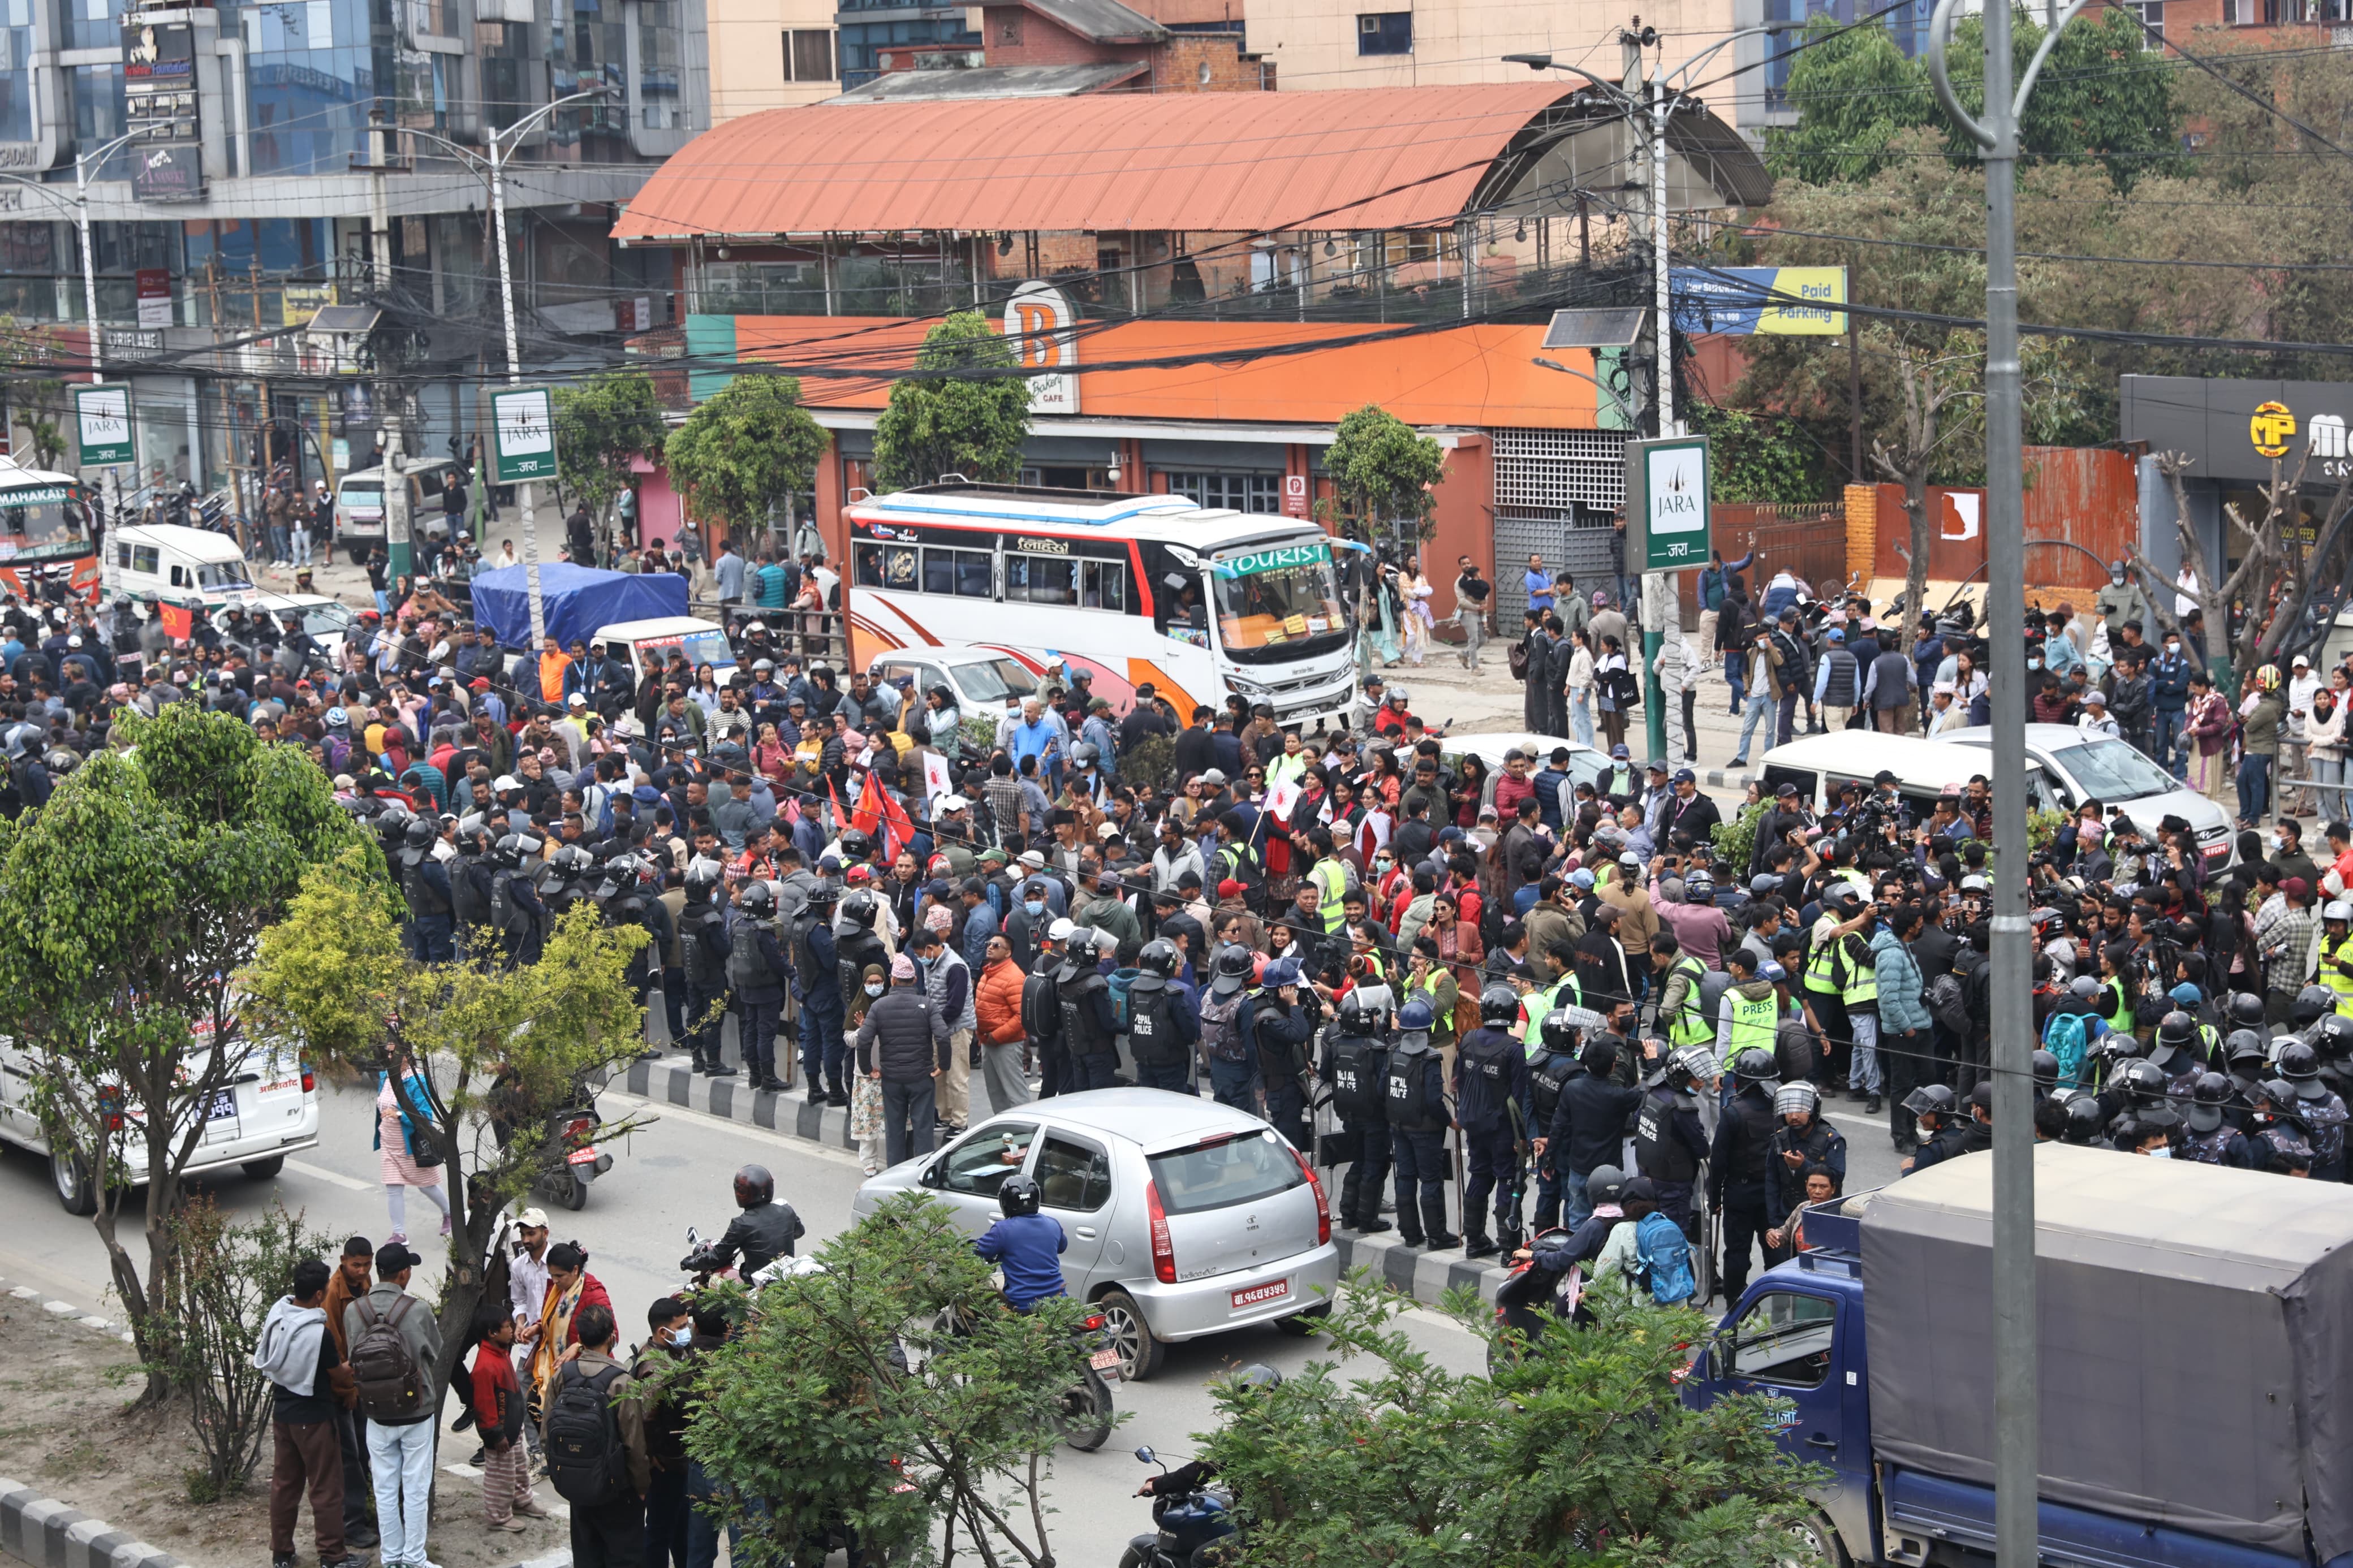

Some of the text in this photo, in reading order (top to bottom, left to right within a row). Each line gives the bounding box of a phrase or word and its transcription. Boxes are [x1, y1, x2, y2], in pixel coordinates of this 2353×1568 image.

[1802, 283, 1831, 298] Paid
[1727, 313, 1740, 321] 999
[1779, 305, 1832, 323] Parking
[109, 332, 157, 349] ORIFLAME
[1014, 303, 1061, 370] B
[1031, 372, 1063, 396] Bakery
[89, 420, 122, 435] JARA
[507, 426, 542, 444] JARA
[97, 450, 115, 460] जरा
[518, 460, 537, 472] जरा
[0, 488, 67, 504] MAHAKALI
[1658, 495, 1696, 518] JARA
[897, 533, 919, 542] Nepal
[1667, 542, 1688, 557] जरा
[1222, 545, 1325, 572] TOURIST
[1743, 1001, 1773, 1016] PRESS
[1134, 1023, 1152, 1035] POLICE
[1482, 1064, 1498, 1075] OLICE
[1544, 1078, 1560, 1091] POLICE
[287, 1107, 300, 1117] EV
[1640, 1114, 1658, 1133] NEPAL
[1639, 1124, 1657, 1142] POLICE
[1180, 1271, 1202, 1280] Indica
